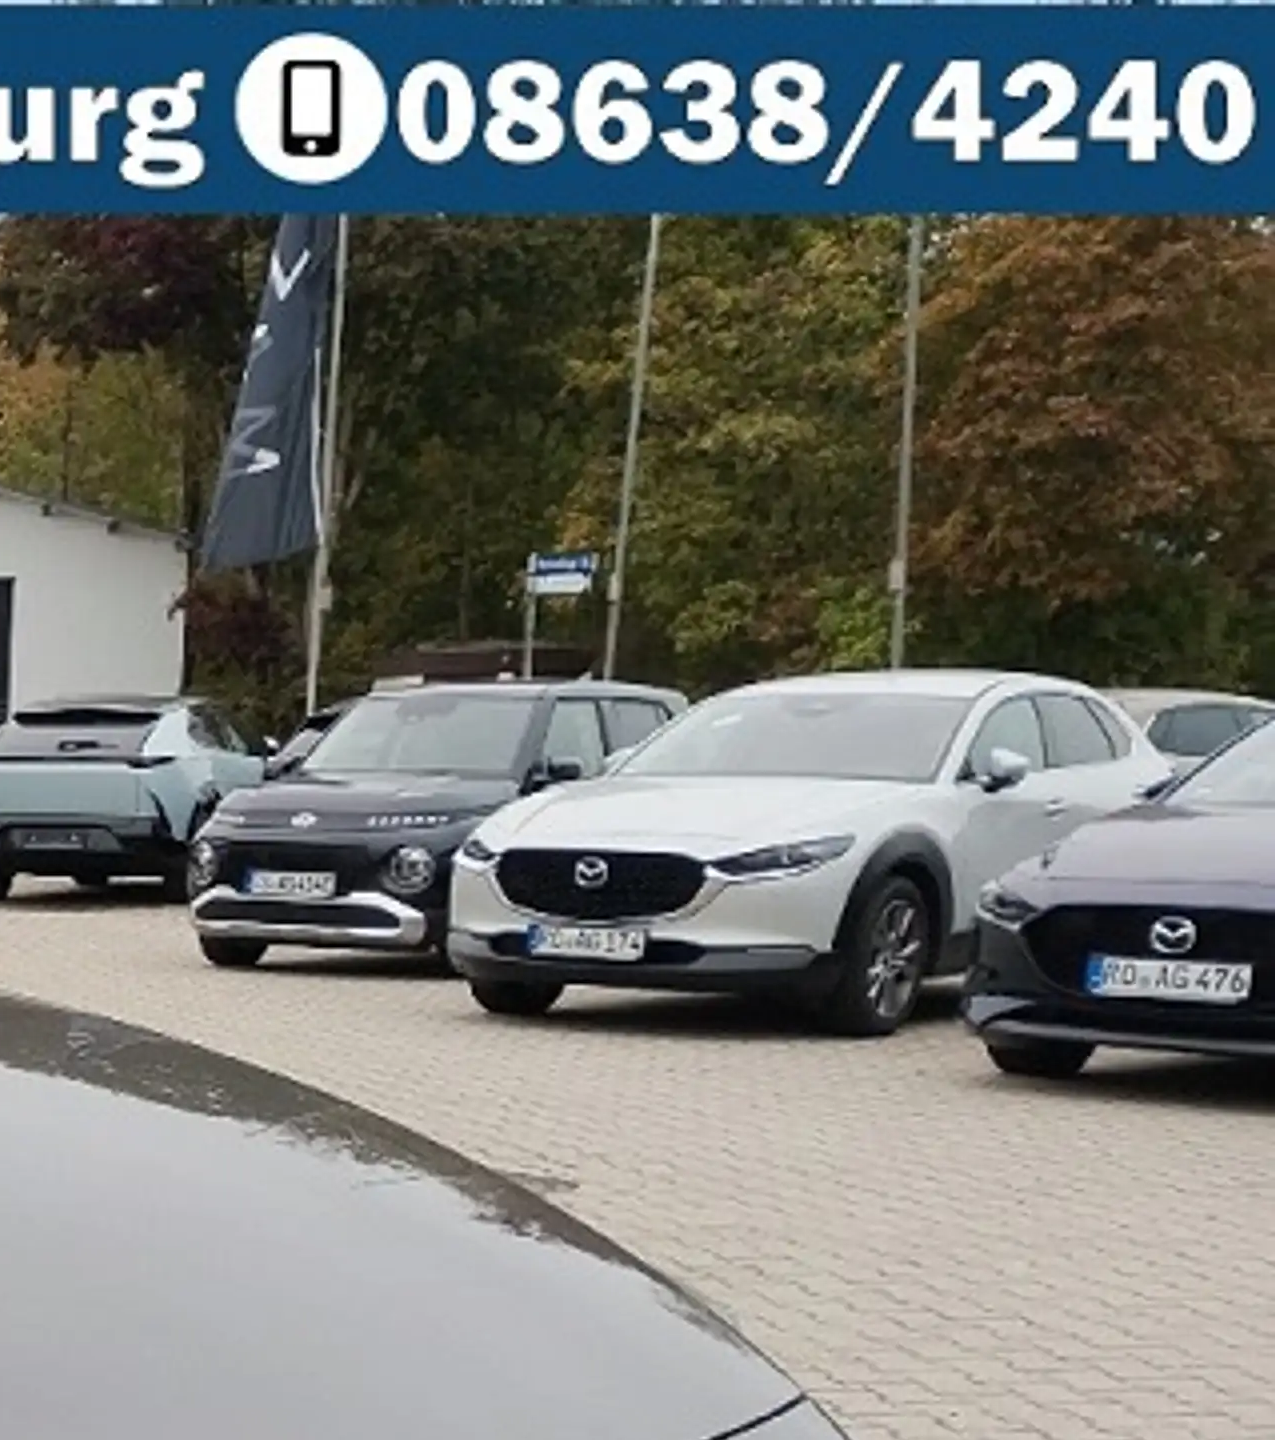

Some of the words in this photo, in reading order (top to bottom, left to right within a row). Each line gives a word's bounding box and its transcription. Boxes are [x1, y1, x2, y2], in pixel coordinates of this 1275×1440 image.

[1102, 959, 1137, 986] RO
[1154, 963, 1190, 989] AG
[1193, 966, 1246, 993] 476
